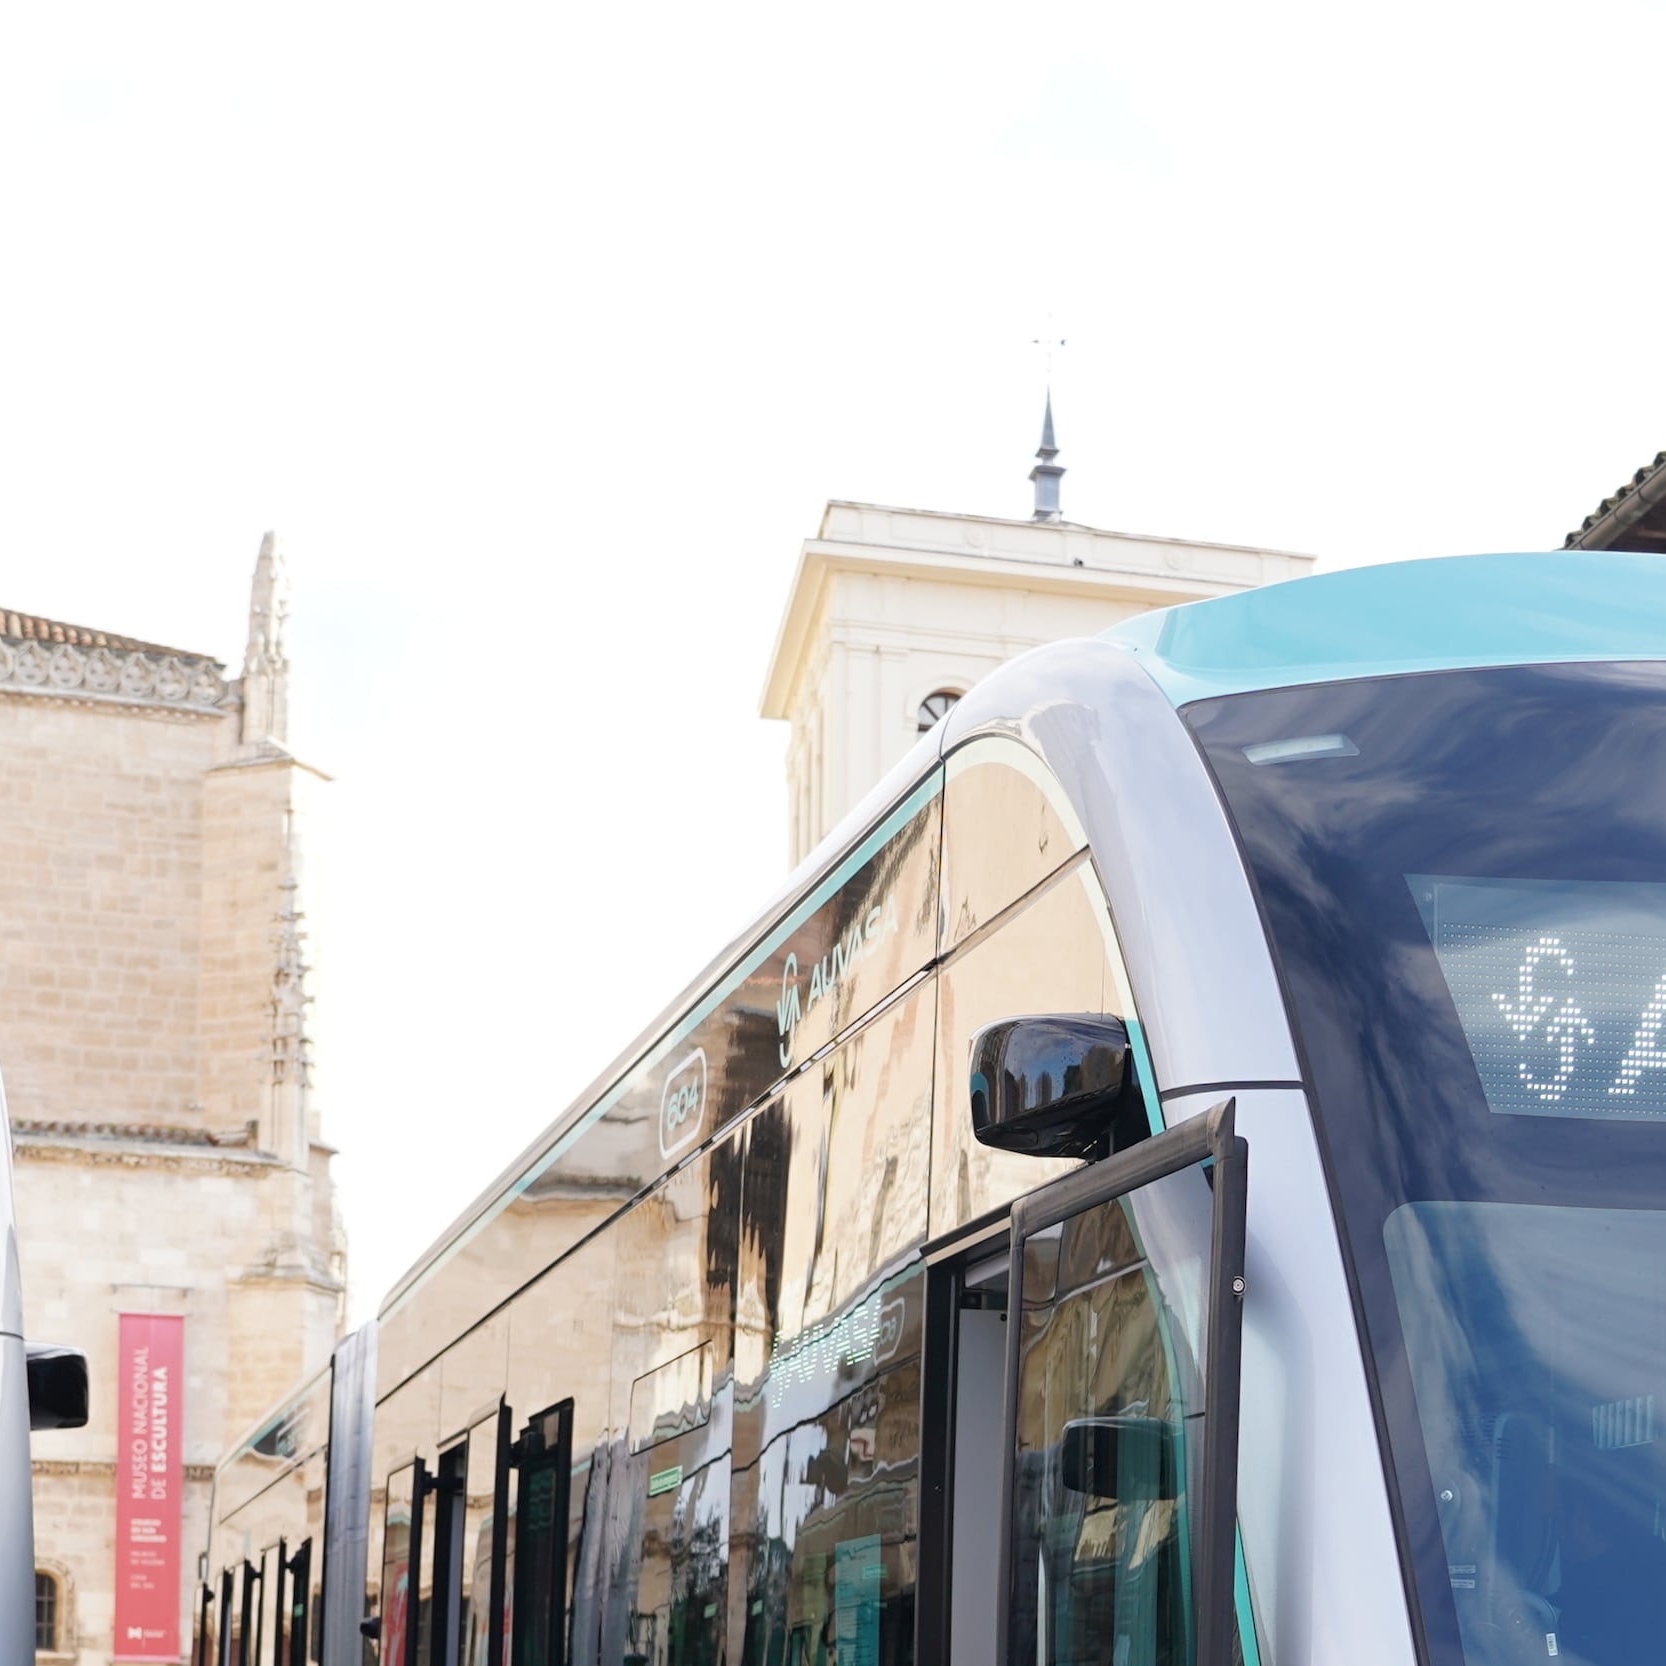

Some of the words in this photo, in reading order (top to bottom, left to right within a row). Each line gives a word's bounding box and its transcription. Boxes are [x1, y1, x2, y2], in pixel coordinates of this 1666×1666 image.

[807, 895, 899, 1012] AUVASA
[666, 1076, 700, 1132] 604
[133, 1346, 150, 1435] NACIONAL
[151, 1366, 169, 1473] ESCULTURA
[131, 1437, 148, 1499] MUSEO
[150, 1477, 167, 1500] DE
